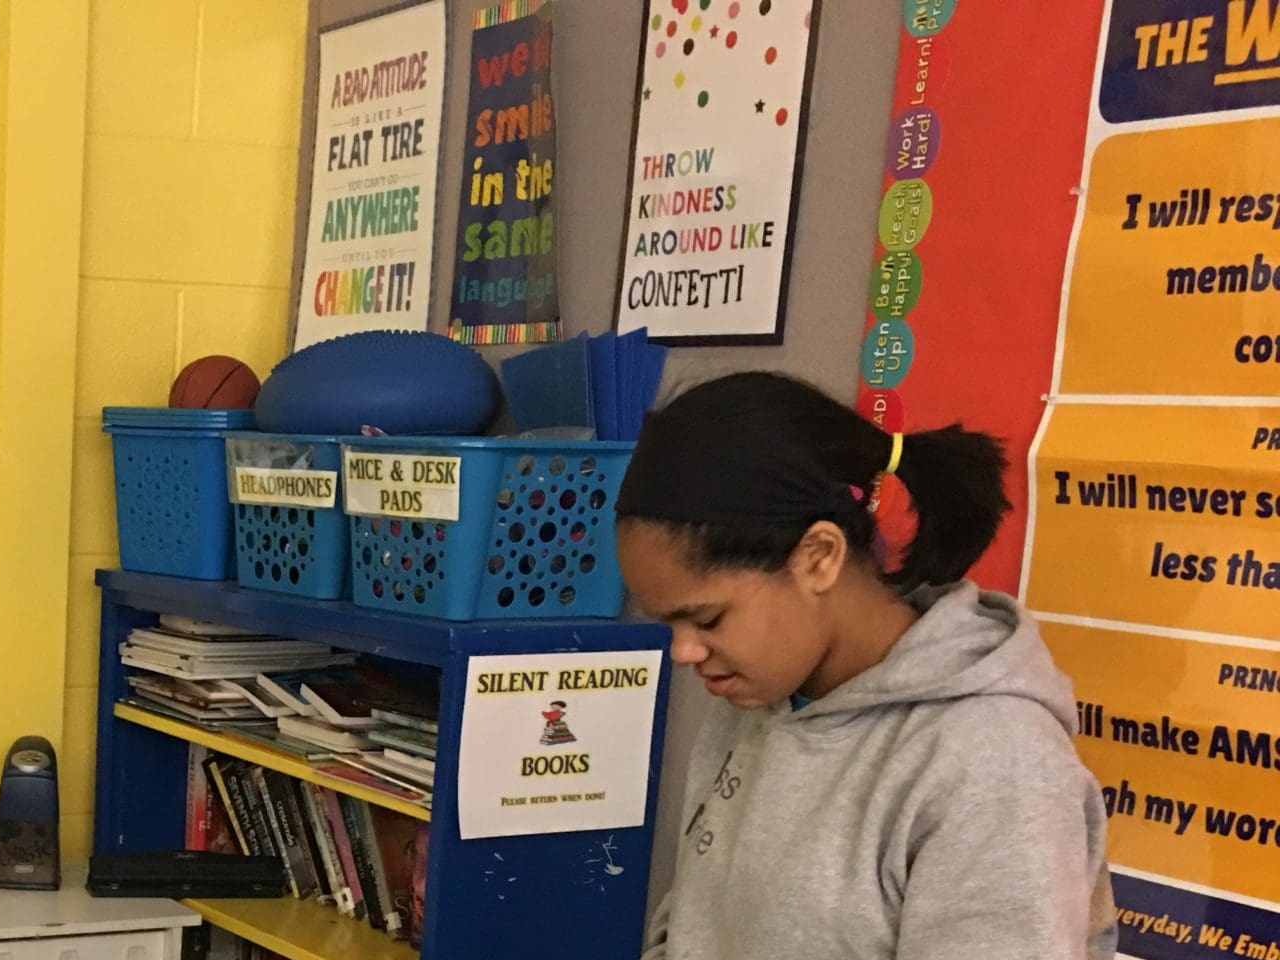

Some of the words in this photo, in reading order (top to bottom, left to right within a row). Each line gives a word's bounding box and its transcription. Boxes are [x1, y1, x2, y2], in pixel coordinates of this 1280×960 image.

[477, 42, 529, 89] we
[1135, 16, 1214, 70] THE
[331, 74, 341, 109] A
[343, 67, 370, 106] BAD
[370, 51, 428, 100] ATTITUDE
[911, 38, 933, 105] Learn!
[328, 130, 373, 172] FLAT
[381, 119, 425, 162] TIRE
[896, 116, 914, 170] Work
[911, 113, 932, 170] Hard!
[470, 156, 504, 207] in
[516, 153, 553, 200] the
[643, 148, 715, 181] THROW
[321, 186, 420, 243] ANYWHERE
[638, 184, 737, 219] KINDNESS
[887, 185, 907, 245] Reach
[904, 183, 922, 243] Goals!
[1122, 194, 1142, 230] I
[1148, 188, 1211, 228] will
[462, 213, 553, 262] same
[634, 226, 722, 257] AROUND
[730, 221, 774, 250] LIKE
[314, 265, 385, 317] CHANGE
[386, 261, 416, 312] IT!
[628, 265, 745, 310] CONFETTI
[876, 284, 889, 307] Be
[890, 252, 913, 316] Happy!
[870, 323, 890, 384] Listen
[887, 336, 907, 371] Up!
[1234, 335, 1280, 363] co
[873, 394, 888, 429] AD!
[240, 474, 332, 498] HEADPHONES
[349, 458, 382, 481] MICE
[390, 461, 404, 482] &
[412, 460, 456, 484] DESK
[380, 489, 423, 513] PADS
[1055, 471, 1070, 504] I
[1078, 473, 1137, 508] will
[1146, 485, 1246, 517] never
[1150, 542, 1217, 583] less
[477, 671, 549, 694] SILENT
[557, 667, 648, 691] READING
[1111, 716, 1200, 755] make
[521, 753, 590, 777] BOOKS
[1144, 794, 1198, 836] my
[1113, 906, 1193, 944] veryday,
[1198, 923, 1232, 951] We
